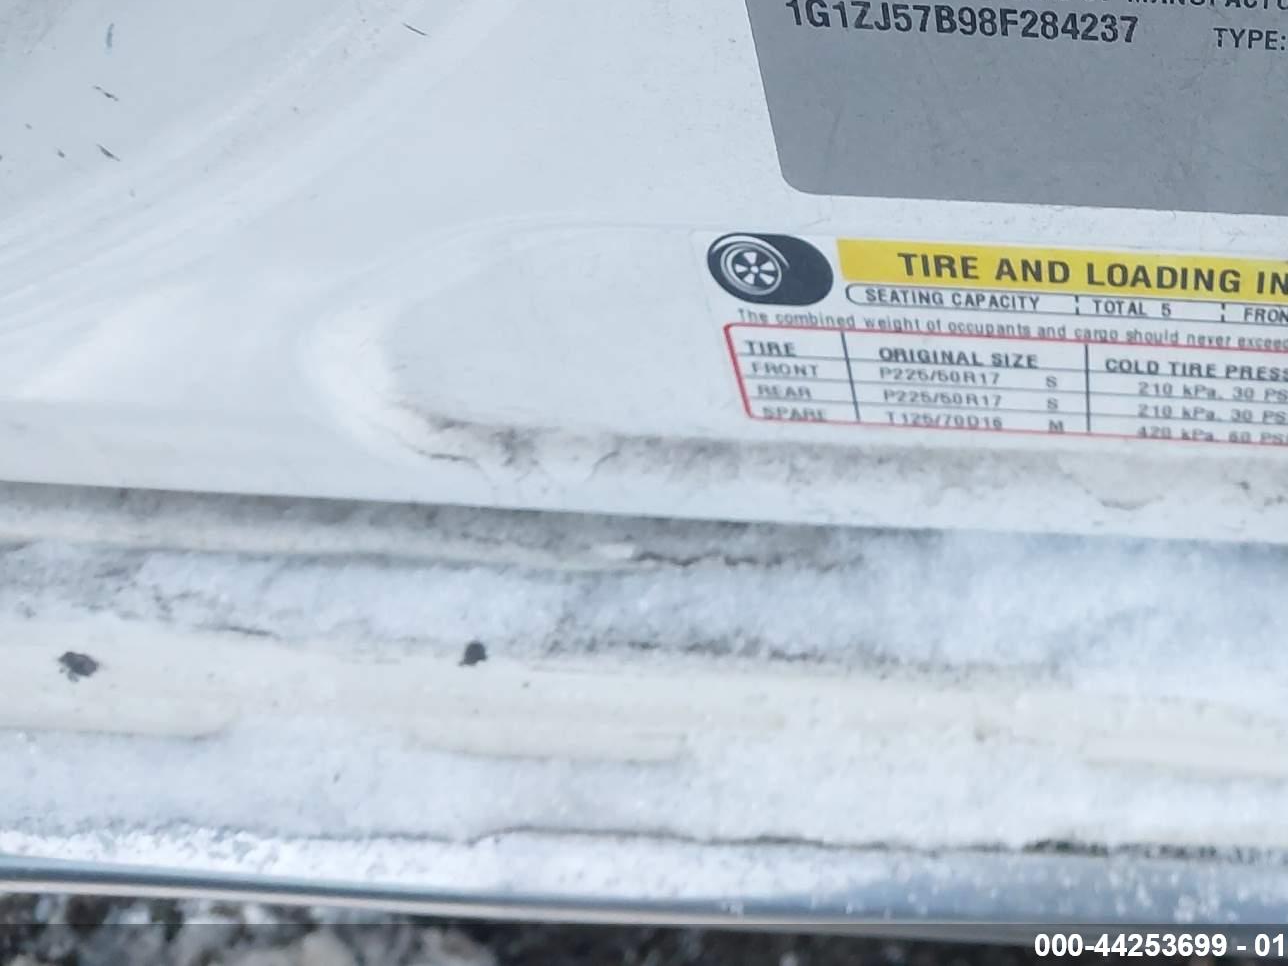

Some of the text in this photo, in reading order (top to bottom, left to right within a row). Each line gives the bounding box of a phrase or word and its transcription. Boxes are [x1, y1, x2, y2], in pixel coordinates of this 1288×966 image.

[1213, 26, 1287, 52] TYPE:
[897, 251, 980, 281] TIRE
[995, 257, 1070, 285] AND
[1087, 262, 1241, 293] LOADING
[865, 287, 1040, 311] SEATING CAPACITY
[1093, 298, 1171, 317] TOTAL 5
[738, 308, 770, 325] The
[776, 309, 856, 329] combined
[864, 315, 920, 335] weight
[925, 317, 943, 332] of
[947, 321, 1031, 339] occupants
[1038, 323, 1066, 340] and
[1074, 326, 1118, 344] cargo
[1126, 326, 1179, 344] should
[1186, 332, 1231, 348] never
[745, 339, 796, 356] TIRE
[879, 345, 1039, 369] ORIGINAL SIZE
[751, 360, 818, 378] FRONT
[879, 366, 1000, 387] P225/50R17
[1105, 356, 1160, 374] COLD
[1168, 361, 1217, 379] TIRE
[757, 383, 812, 400] REAR
[1138, 379, 1172, 396] 210
[884, 388, 1002, 409] P225/50R17
